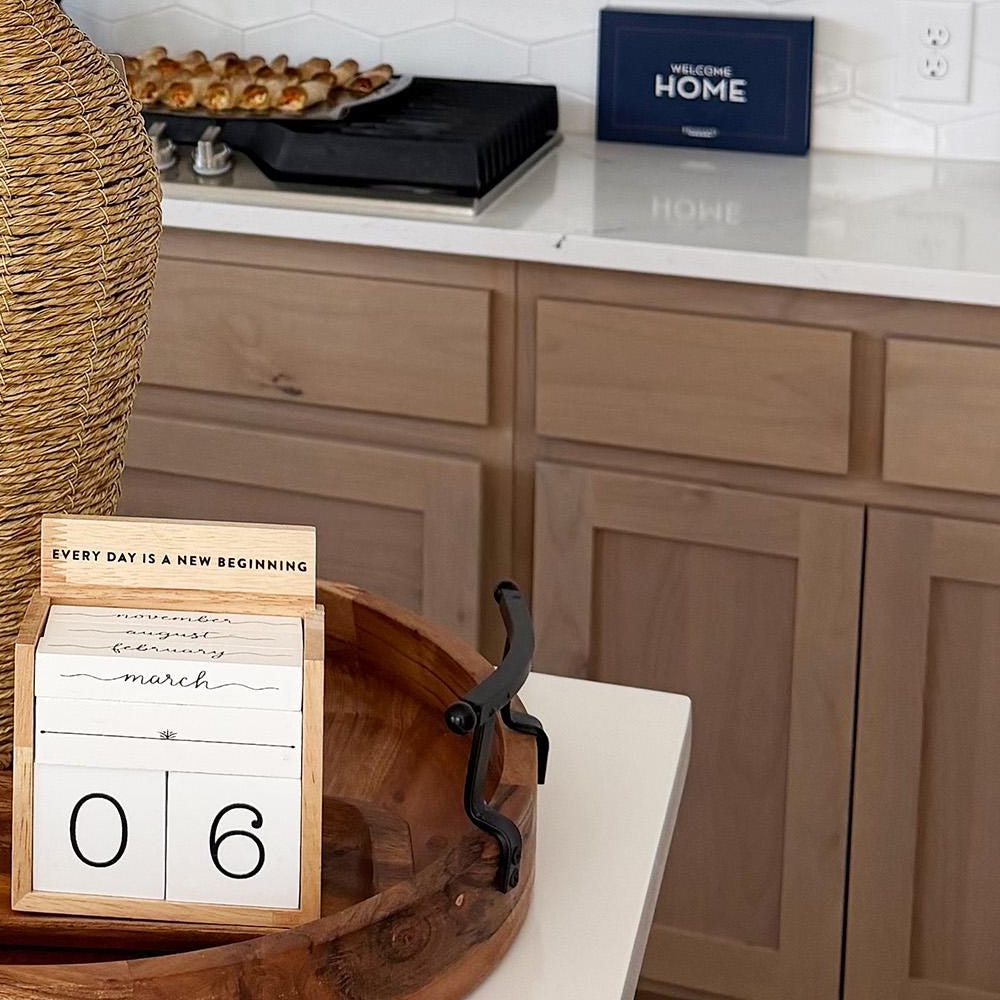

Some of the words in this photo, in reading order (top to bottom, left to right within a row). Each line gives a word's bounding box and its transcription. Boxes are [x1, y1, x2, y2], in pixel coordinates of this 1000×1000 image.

[671, 63, 732, 77] WELCOME
[655, 74, 748, 103] HOME
[52, 549, 100, 561] EVERY
[107, 552, 136, 564] DAY
[143, 553, 156, 564] IS
[161, 555, 171, 565] A
[177, 555, 211, 567] NEW
[218, 558, 307, 572] BEGINNING
[115, 613, 232, 624] november
[125, 629, 219, 640] august
[112, 642, 226, 659] february
[121, 670, 210, 690] march
[69, 792, 128, 868] 0
[209, 803, 265, 880] 6
